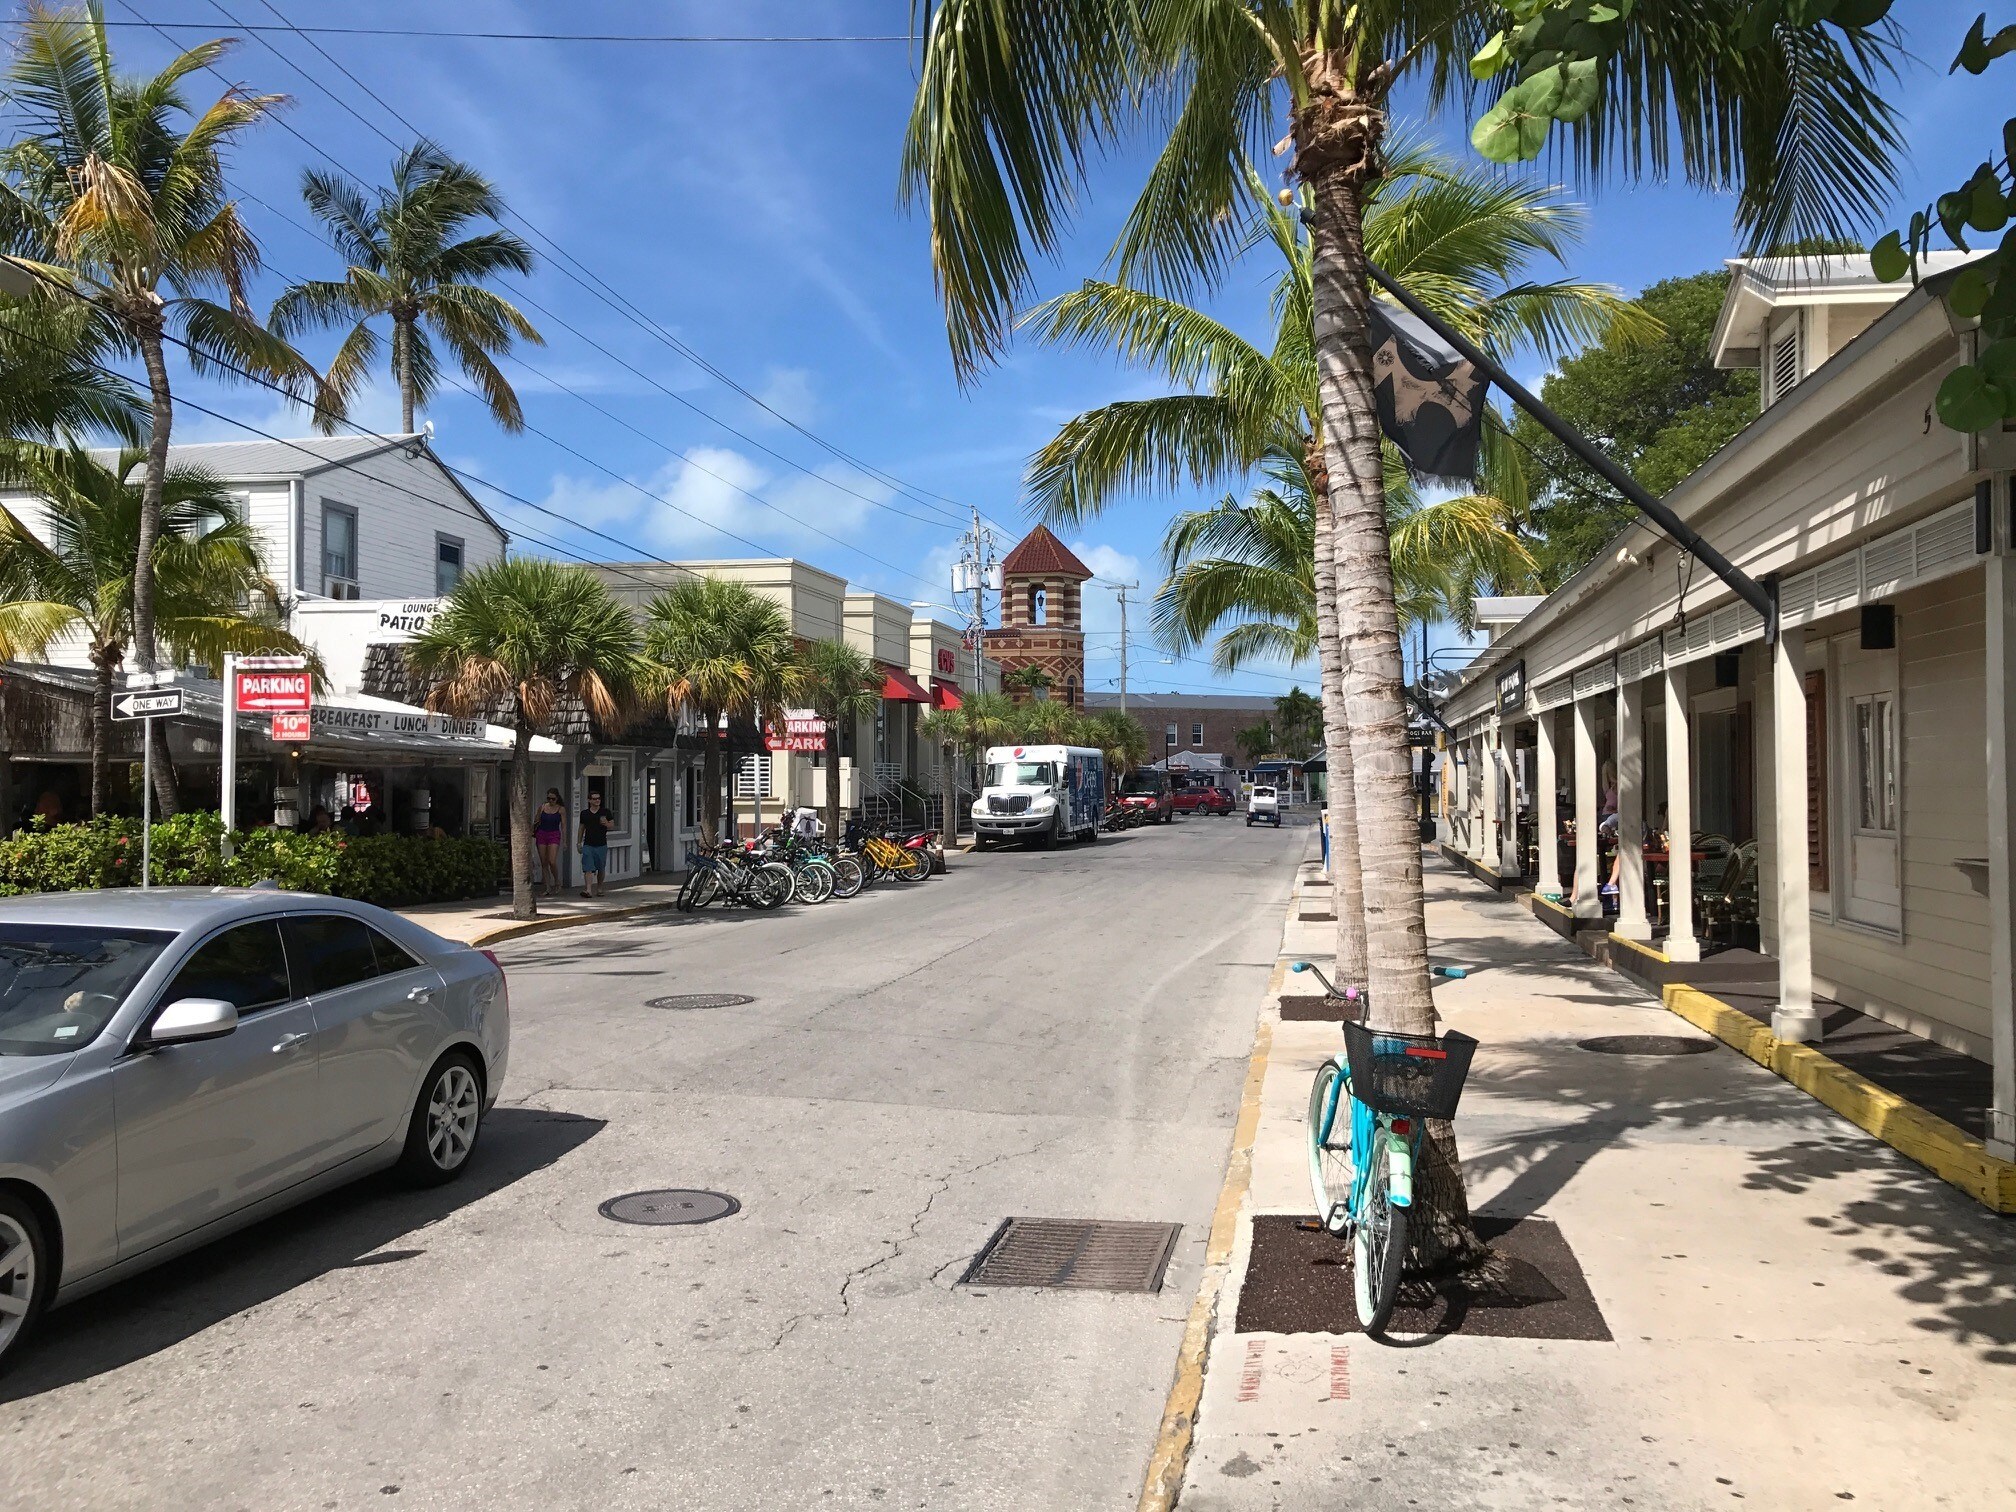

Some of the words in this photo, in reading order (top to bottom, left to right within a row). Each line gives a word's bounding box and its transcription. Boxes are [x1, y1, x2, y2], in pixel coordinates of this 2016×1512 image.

[402, 603, 439, 613] LOUNGE
[242, 677, 306, 694] PARKING
[133, 699, 152, 710] ONE
[155, 697, 175, 708] WAY
[311, 709, 381, 728] BREAKFAST
[393, 715, 428, 732] LUNCH
[441, 719, 477, 735] DINNER
[784, 738, 826, 750] PARK
